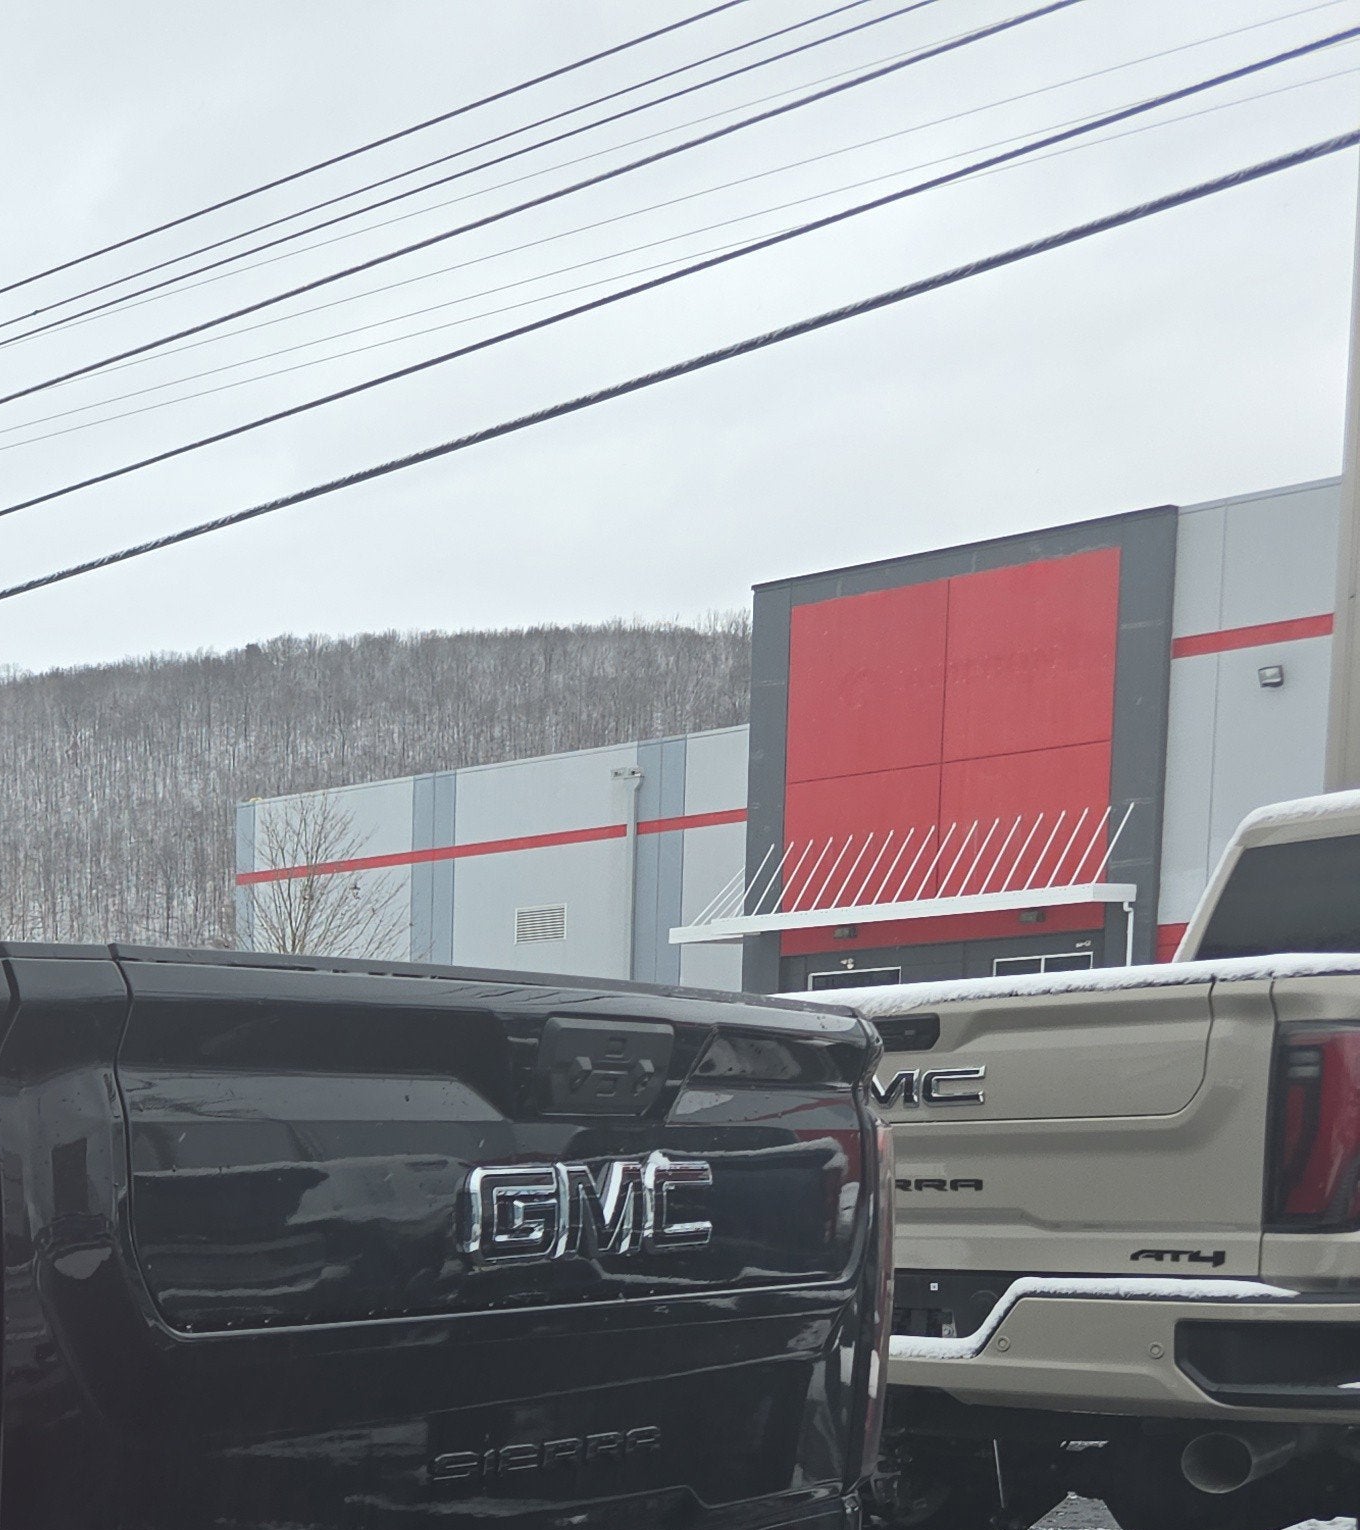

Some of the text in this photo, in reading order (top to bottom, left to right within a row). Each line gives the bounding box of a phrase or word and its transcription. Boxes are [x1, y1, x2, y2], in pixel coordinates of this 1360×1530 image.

[870, 1065, 986, 1105] MC
[458, 1158, 713, 1262] GMC
[1130, 1249, 1225, 1268] AT4
[430, 1425, 662, 1482] SIERRA
